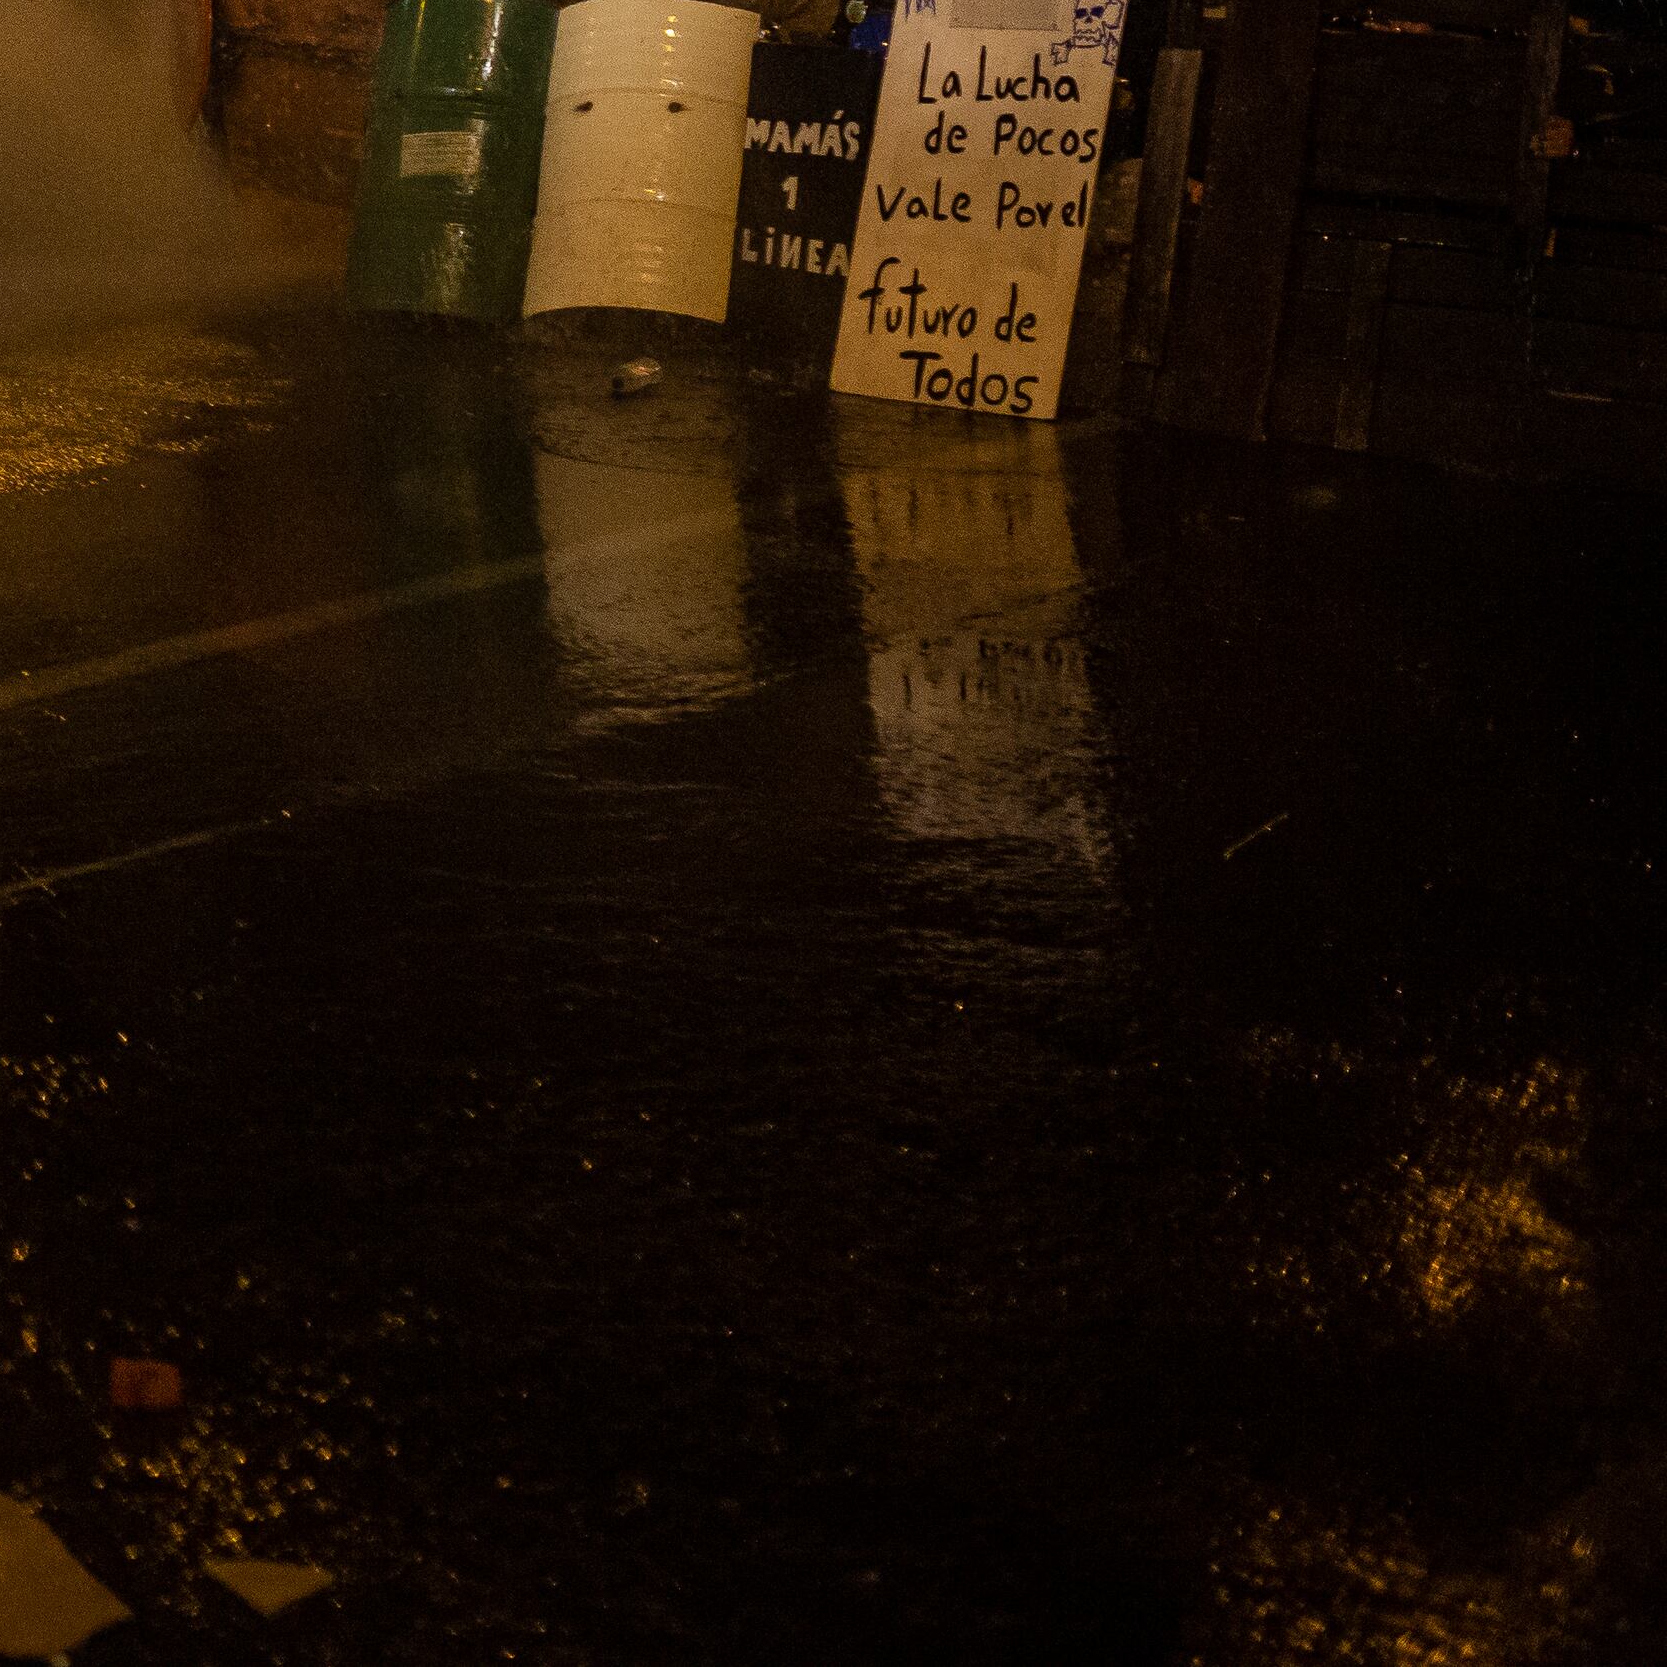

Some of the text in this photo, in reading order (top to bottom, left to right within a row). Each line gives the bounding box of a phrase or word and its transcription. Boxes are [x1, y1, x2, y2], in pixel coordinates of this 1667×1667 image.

[919, 42, 1079, 103] La Lucha
[745, 110, 860, 161] MAMÁS
[925, 111, 1098, 162] de Pocos
[782, 176, 801, 212] 1
[997, 182, 1054, 229] Por
[1062, 182, 1089, 227] el
[859, 257, 1037, 341] futuro de
[900, 351, 1040, 411] Todos
